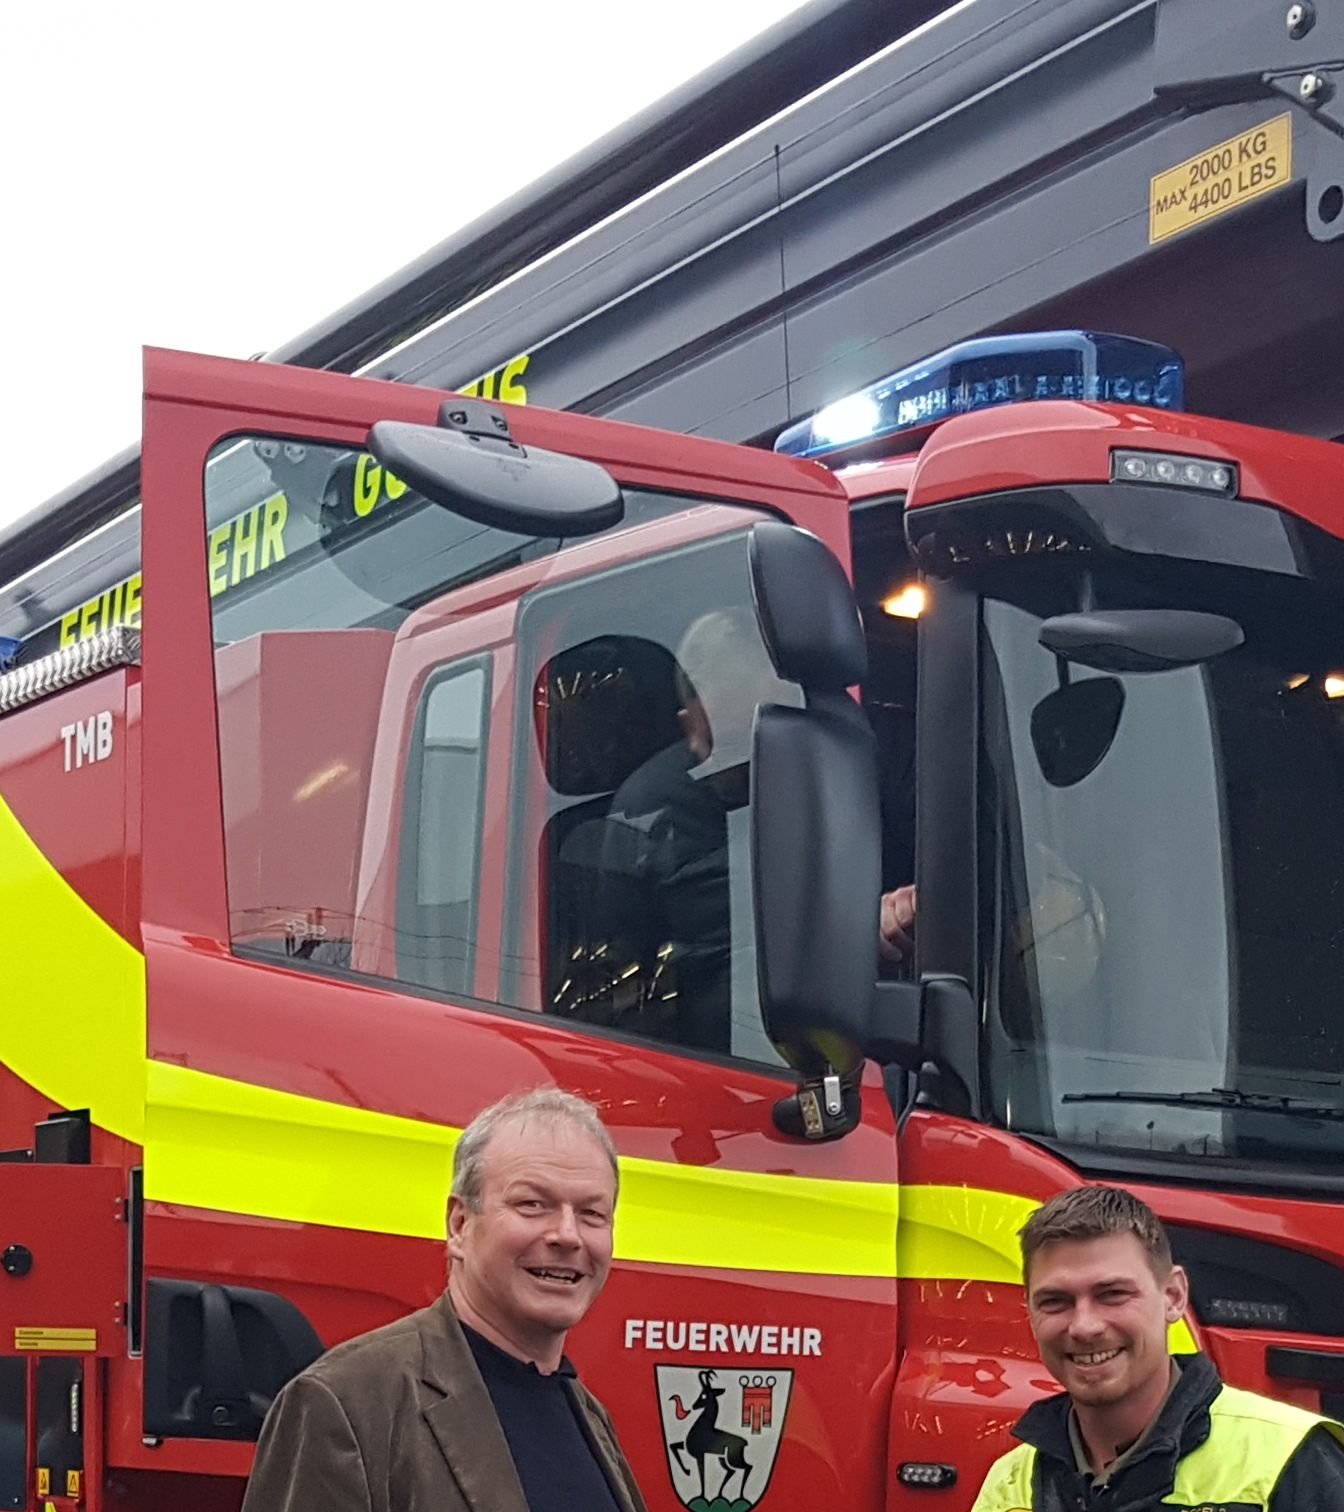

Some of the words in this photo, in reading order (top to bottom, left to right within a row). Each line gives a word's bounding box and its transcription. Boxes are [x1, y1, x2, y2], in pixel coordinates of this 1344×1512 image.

[1188, 178, 1232, 213] 4400
[1238, 156, 1277, 193] LBS
[1189, 149, 1233, 187] 2000
[1239, 132, 1267, 163] KG
[1155, 187, 1188, 215] MAX
[60, 710, 113, 773] TMB
[624, 1319, 822, 1356] FEUERWEHR
